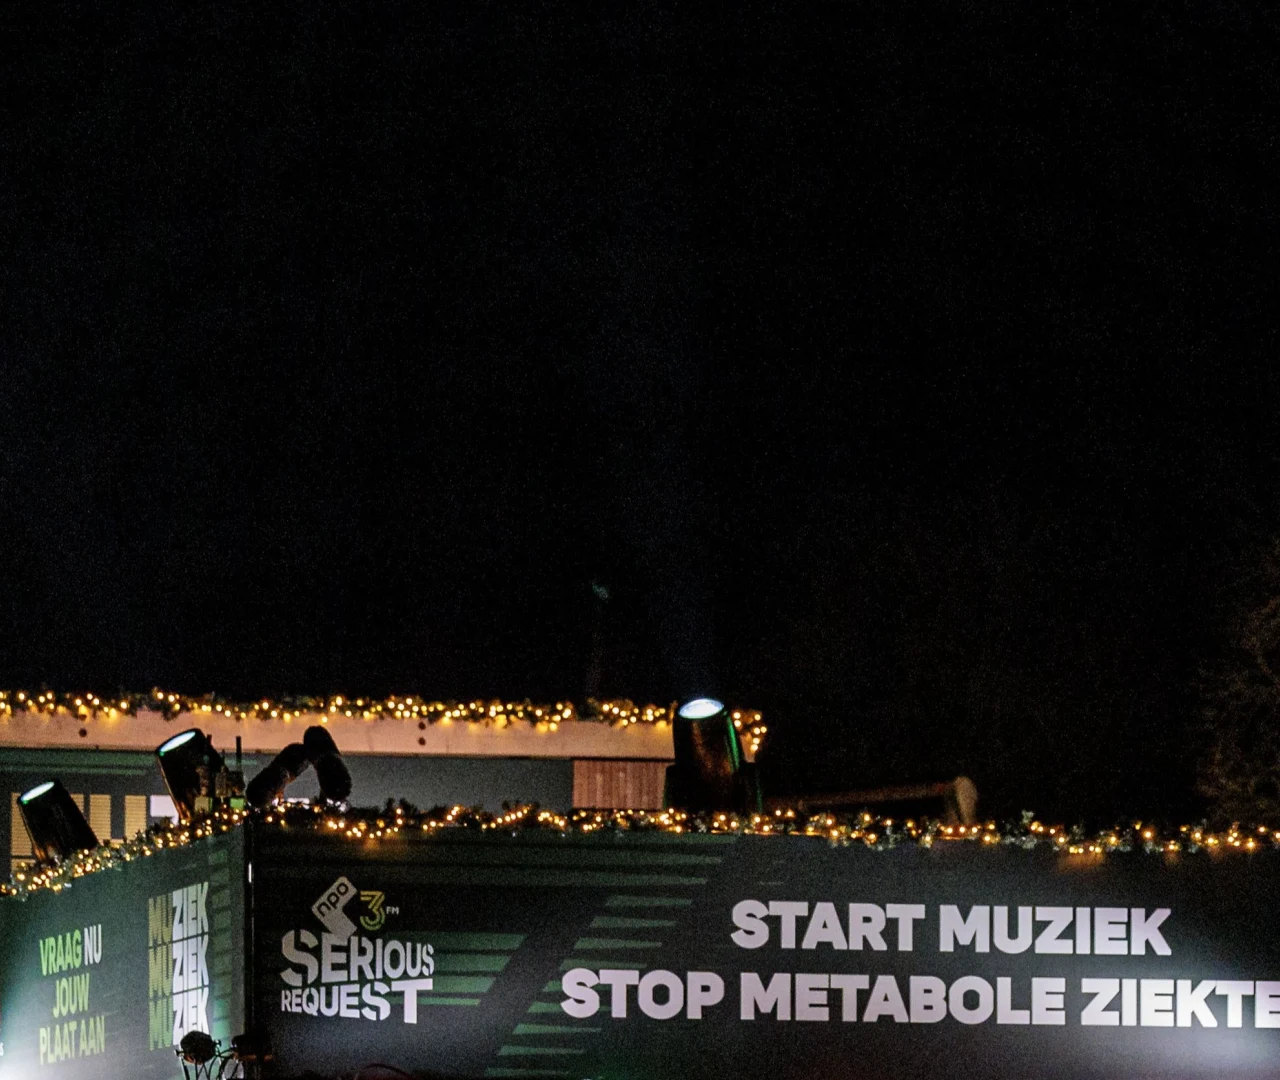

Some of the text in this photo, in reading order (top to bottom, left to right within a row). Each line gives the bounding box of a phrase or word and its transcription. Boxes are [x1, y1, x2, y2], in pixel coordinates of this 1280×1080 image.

[148, 882, 209, 948] MUZIEK
[316, 881, 350, 917] npo
[39, 924, 102, 976] VRAAG NU
[731, 900, 1172, 956] START MUZIEK
[148, 934, 210, 1001] MUZIEK
[280, 929, 435, 987] SERIOUS
[52, 973, 90, 1018] JOUW
[280, 978, 434, 1025] REQUEST
[561, 968, 725, 1020] STOP
[740, 972, 1067, 1027] METABOLE
[39, 1016, 105, 1066] PLAAT AAN
